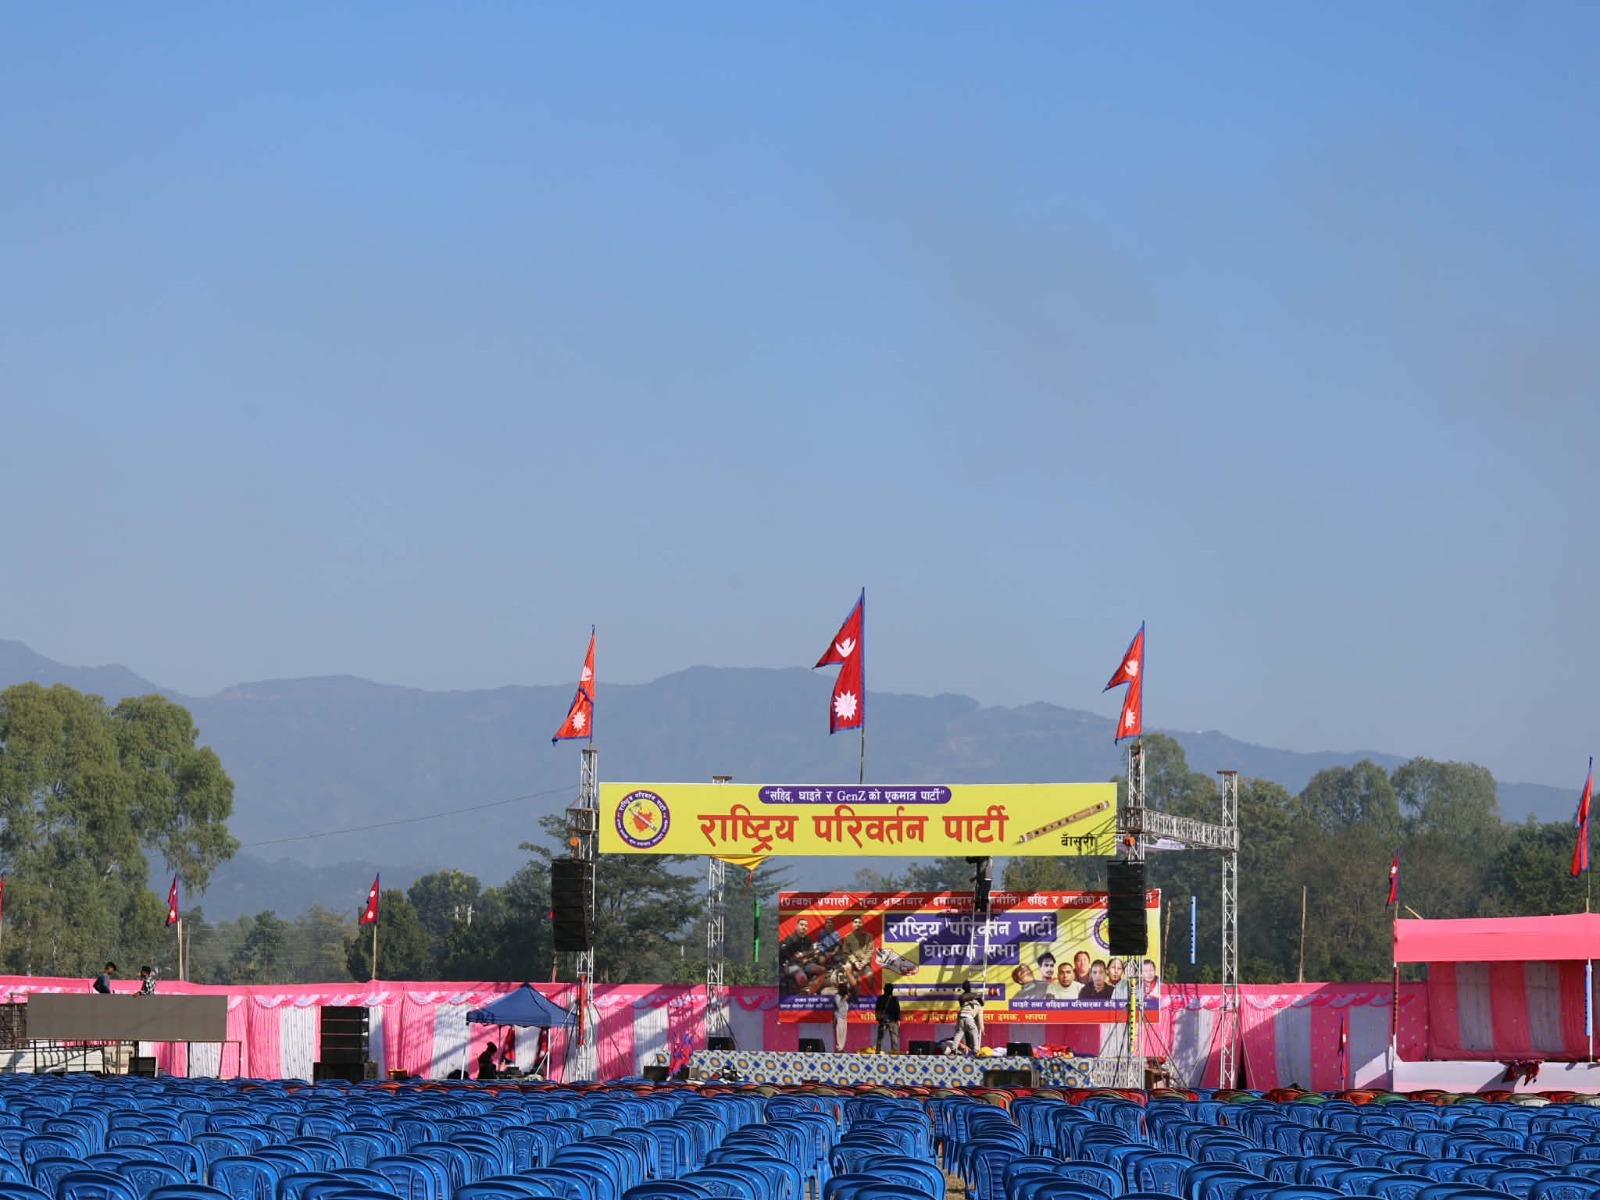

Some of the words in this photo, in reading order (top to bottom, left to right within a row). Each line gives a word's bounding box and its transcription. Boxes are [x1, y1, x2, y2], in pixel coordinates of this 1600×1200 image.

[798, 788, 823, 802] घाइते
[825, 791, 834, 803] र
[836, 790, 866, 802] GenZ
[868, 788, 880, 801] को
[884, 791, 916, 803] एकमात्र
[697, 804, 800, 854] राष्ट्रिय
[812, 804, 930, 848] परिवर्तन
[942, 804, 1010, 844] पार्टी
[1051, 896, 1060, 907] र
[887, 916, 943, 943] राष्ट्रिय
[1018, 915, 1055, 937] पार्टी
[924, 940, 979, 959] घोषणा
[984, 943, 1018, 959] सभा
